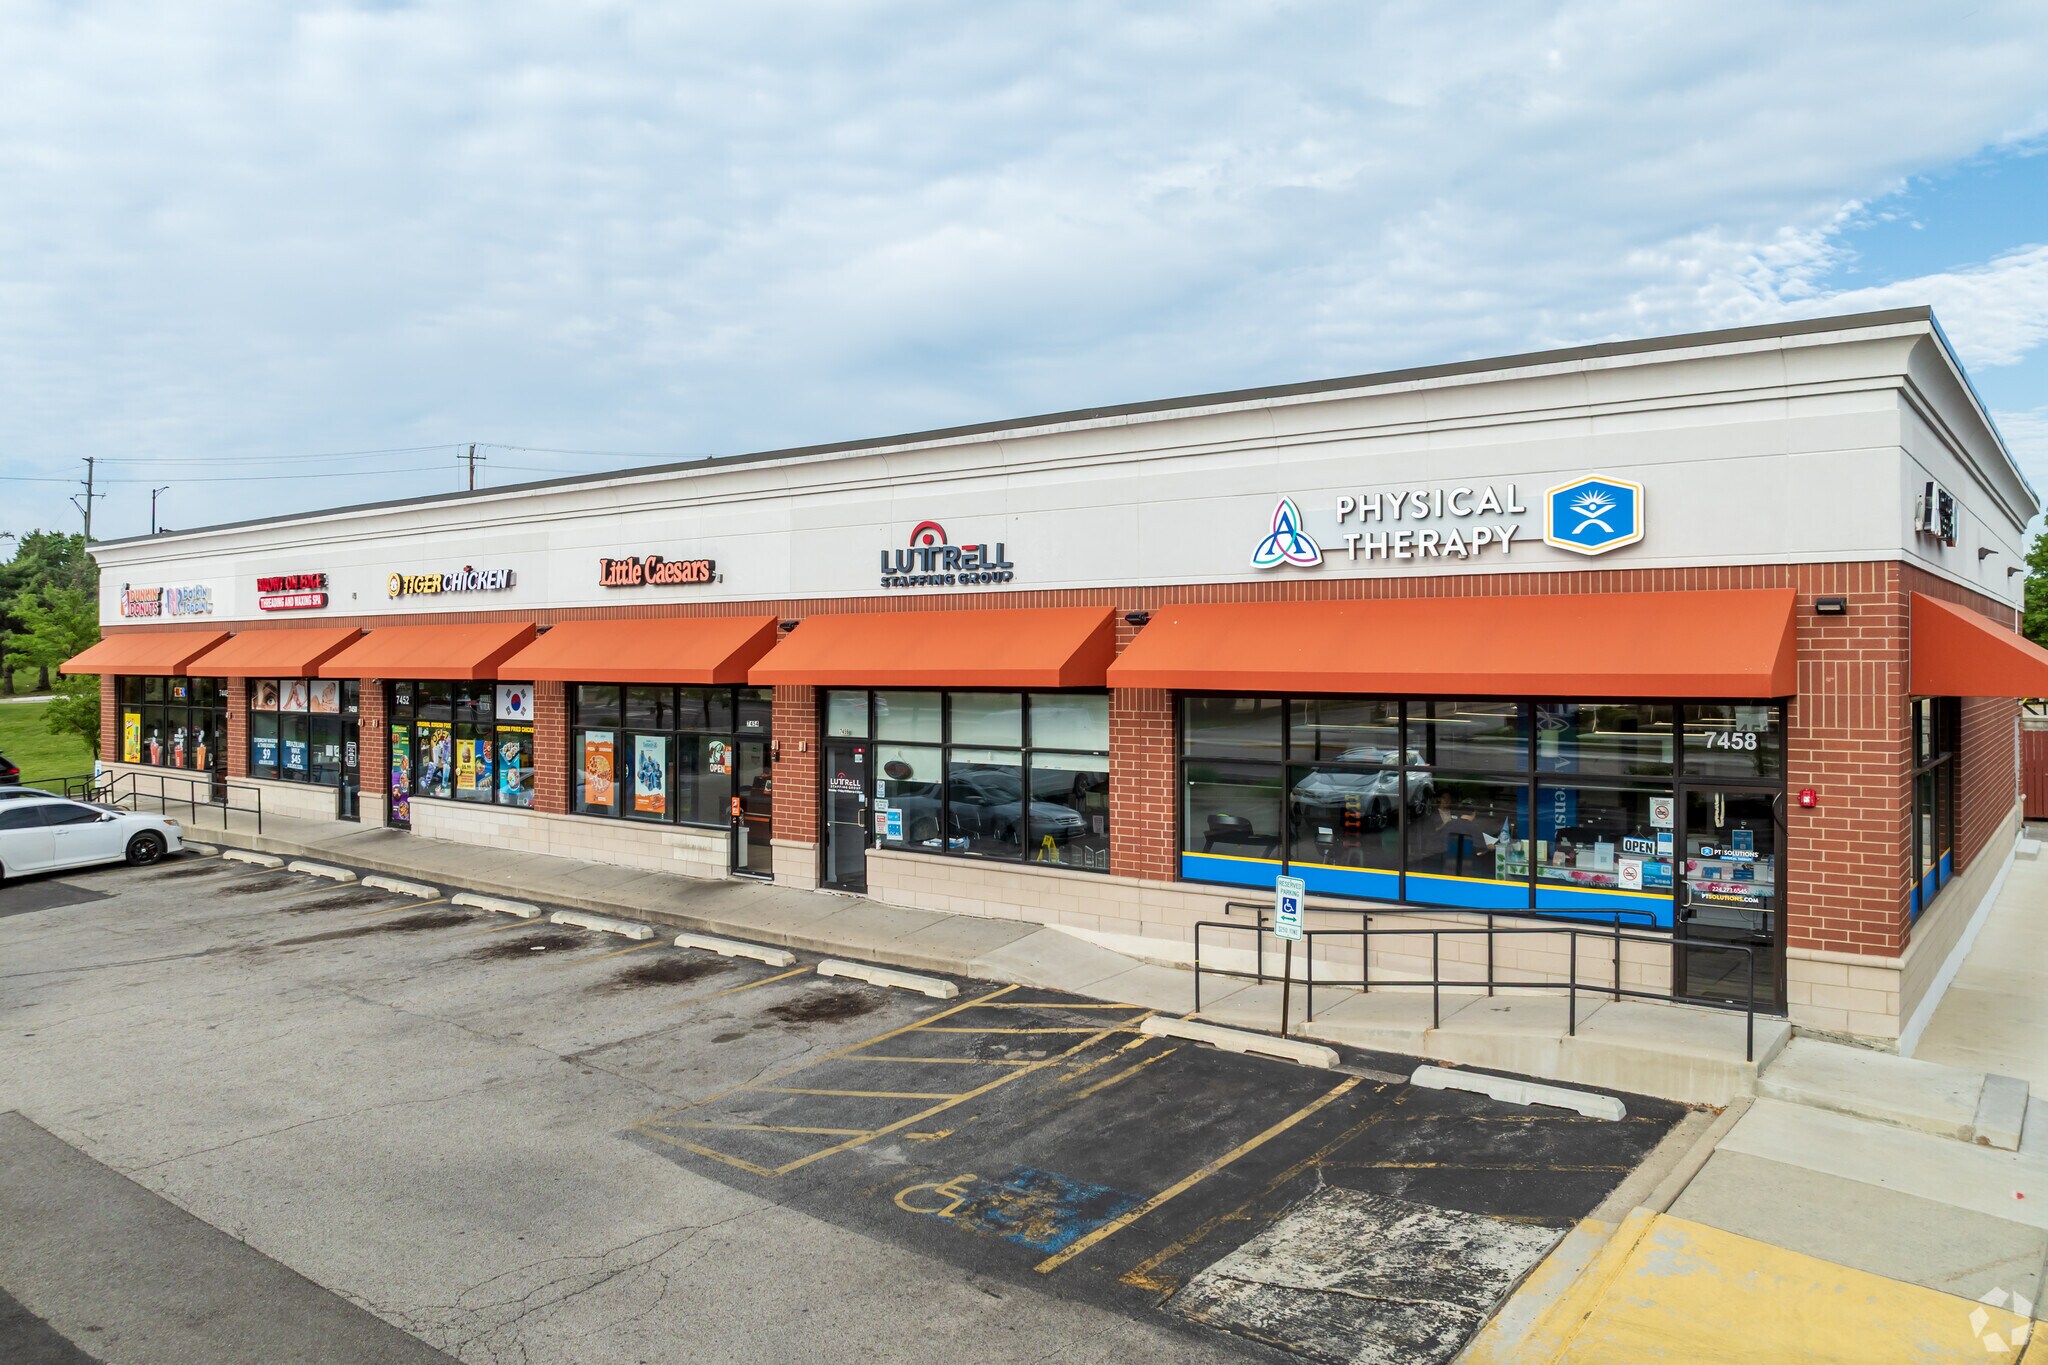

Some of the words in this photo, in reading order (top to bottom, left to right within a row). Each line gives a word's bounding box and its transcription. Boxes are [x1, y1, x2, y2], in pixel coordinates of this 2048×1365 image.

[1336, 484, 1526, 523] PHYSICAL
[1343, 524, 1519, 561] THERAPY
[881, 543, 1014, 574] LUTTRELL
[600, 558, 642, 586] Little
[644, 556, 711, 585] Caesars
[285, 575, 298, 590] ON
[300, 573, 321, 589] EDGE
[881, 574, 955, 588] STAFFING
[958, 571, 1014, 586] GROUP
[285, 596, 295, 607] AND
[312, 594, 322, 606] SPA
[130, 602, 158, 616] DONUTS
[396, 695, 410, 705] 7452
[1704, 731, 1757, 751] 7458
[709, 763, 724, 774] OPEN
[1625, 840, 1653, 854] OPEN
[1724, 849, 1759, 858] SOLUTIONS
[1281, 889, 1299, 897] PARKING
